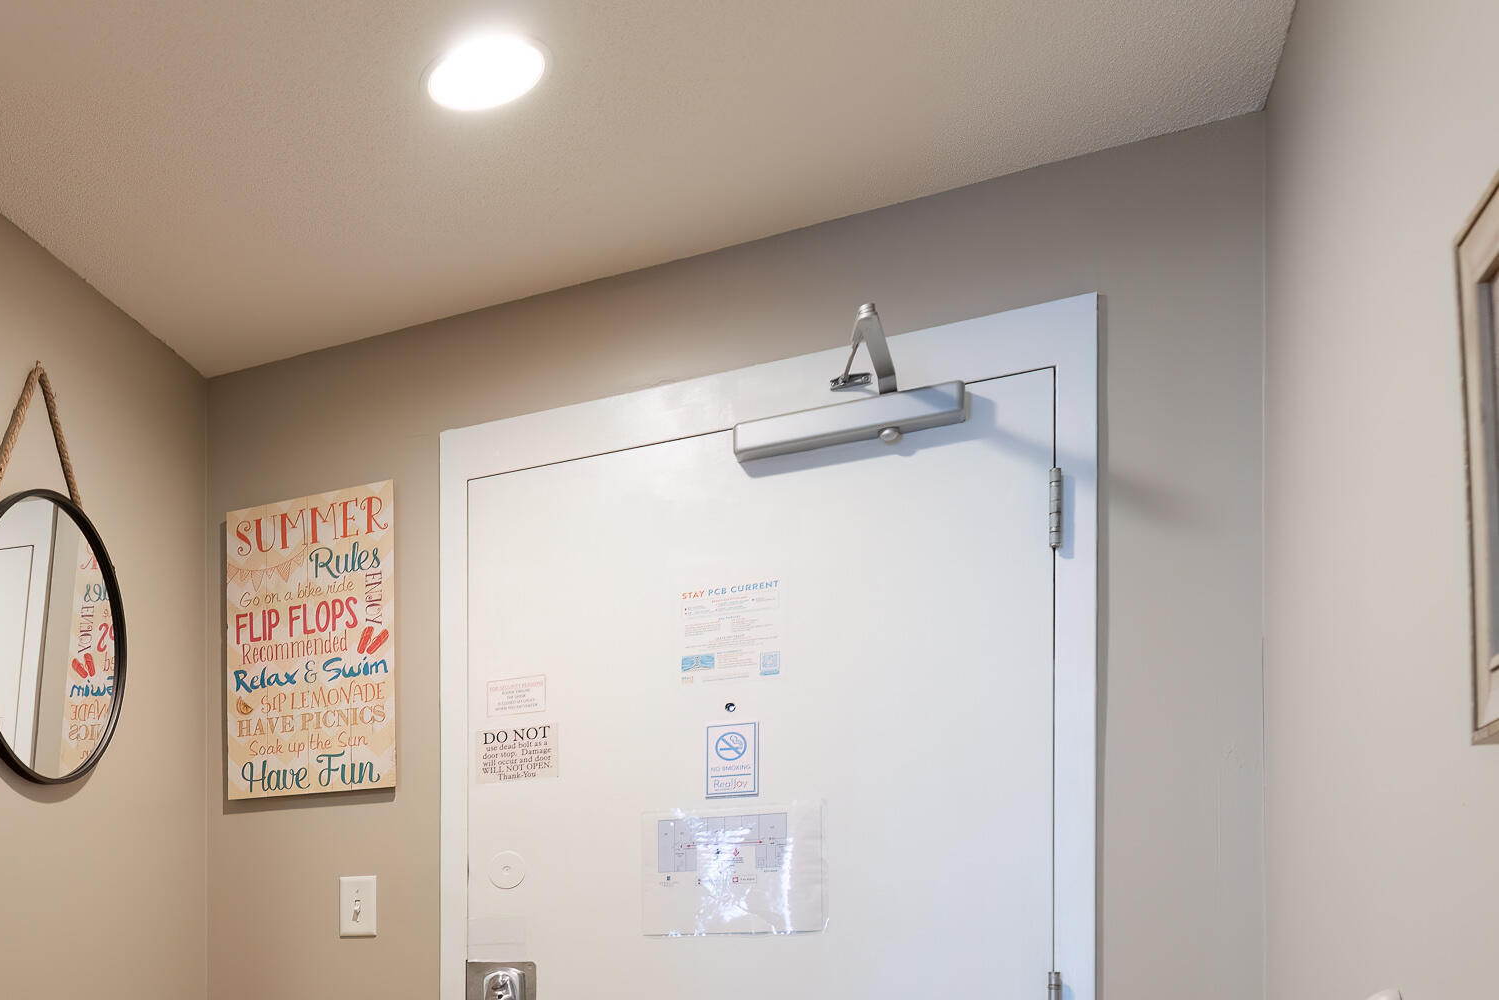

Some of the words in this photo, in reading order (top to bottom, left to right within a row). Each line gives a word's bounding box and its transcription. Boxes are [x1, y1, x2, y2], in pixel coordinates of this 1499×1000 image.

[236, 496, 388, 556] SUMMER
[309, 542, 381, 579] Rules
[240, 591, 260, 608] Go
[264, 592, 281, 605] on
[284, 590, 293, 601] a
[297, 582, 323, 598] bike
[326, 575, 355, 593] ride
[365, 570, 383, 625] ENJOY
[681, 590, 705, 600] STAY
[708, 587, 727, 597] PCB
[730, 580, 779, 593] CURRENT
[235, 608, 280, 645] FLIP
[289, 596, 358, 637] FLOPS
[242, 630, 349, 665] Recommended
[233, 667, 300, 693] Relax
[304, 660, 318, 684] &
[322, 656, 389, 682] Swim
[260, 691, 287, 713] SIP
[290, 680, 386, 710] LEMONADE
[237, 714, 294, 738] HAVE
[300, 704, 386, 731] PICNICS
[484, 730, 508, 745] DO
[513, 726, 551, 741] NOT
[249, 738, 283, 757] Soak
[287, 741, 305, 757] up
[310, 733, 332, 751] the
[337, 731, 368, 748] Sun
[482, 752, 498, 760] door
[521, 748, 552, 757] Damage
[499, 742, 516, 751] dead
[518, 740, 533, 749] bolt
[241, 760, 310, 793] Have
[316, 750, 381, 787] Fun
[482, 759, 496, 767] will
[482, 766, 504, 774] WILL
[506, 764, 525, 772] NOT
[498, 771, 537, 781] Thank-You
